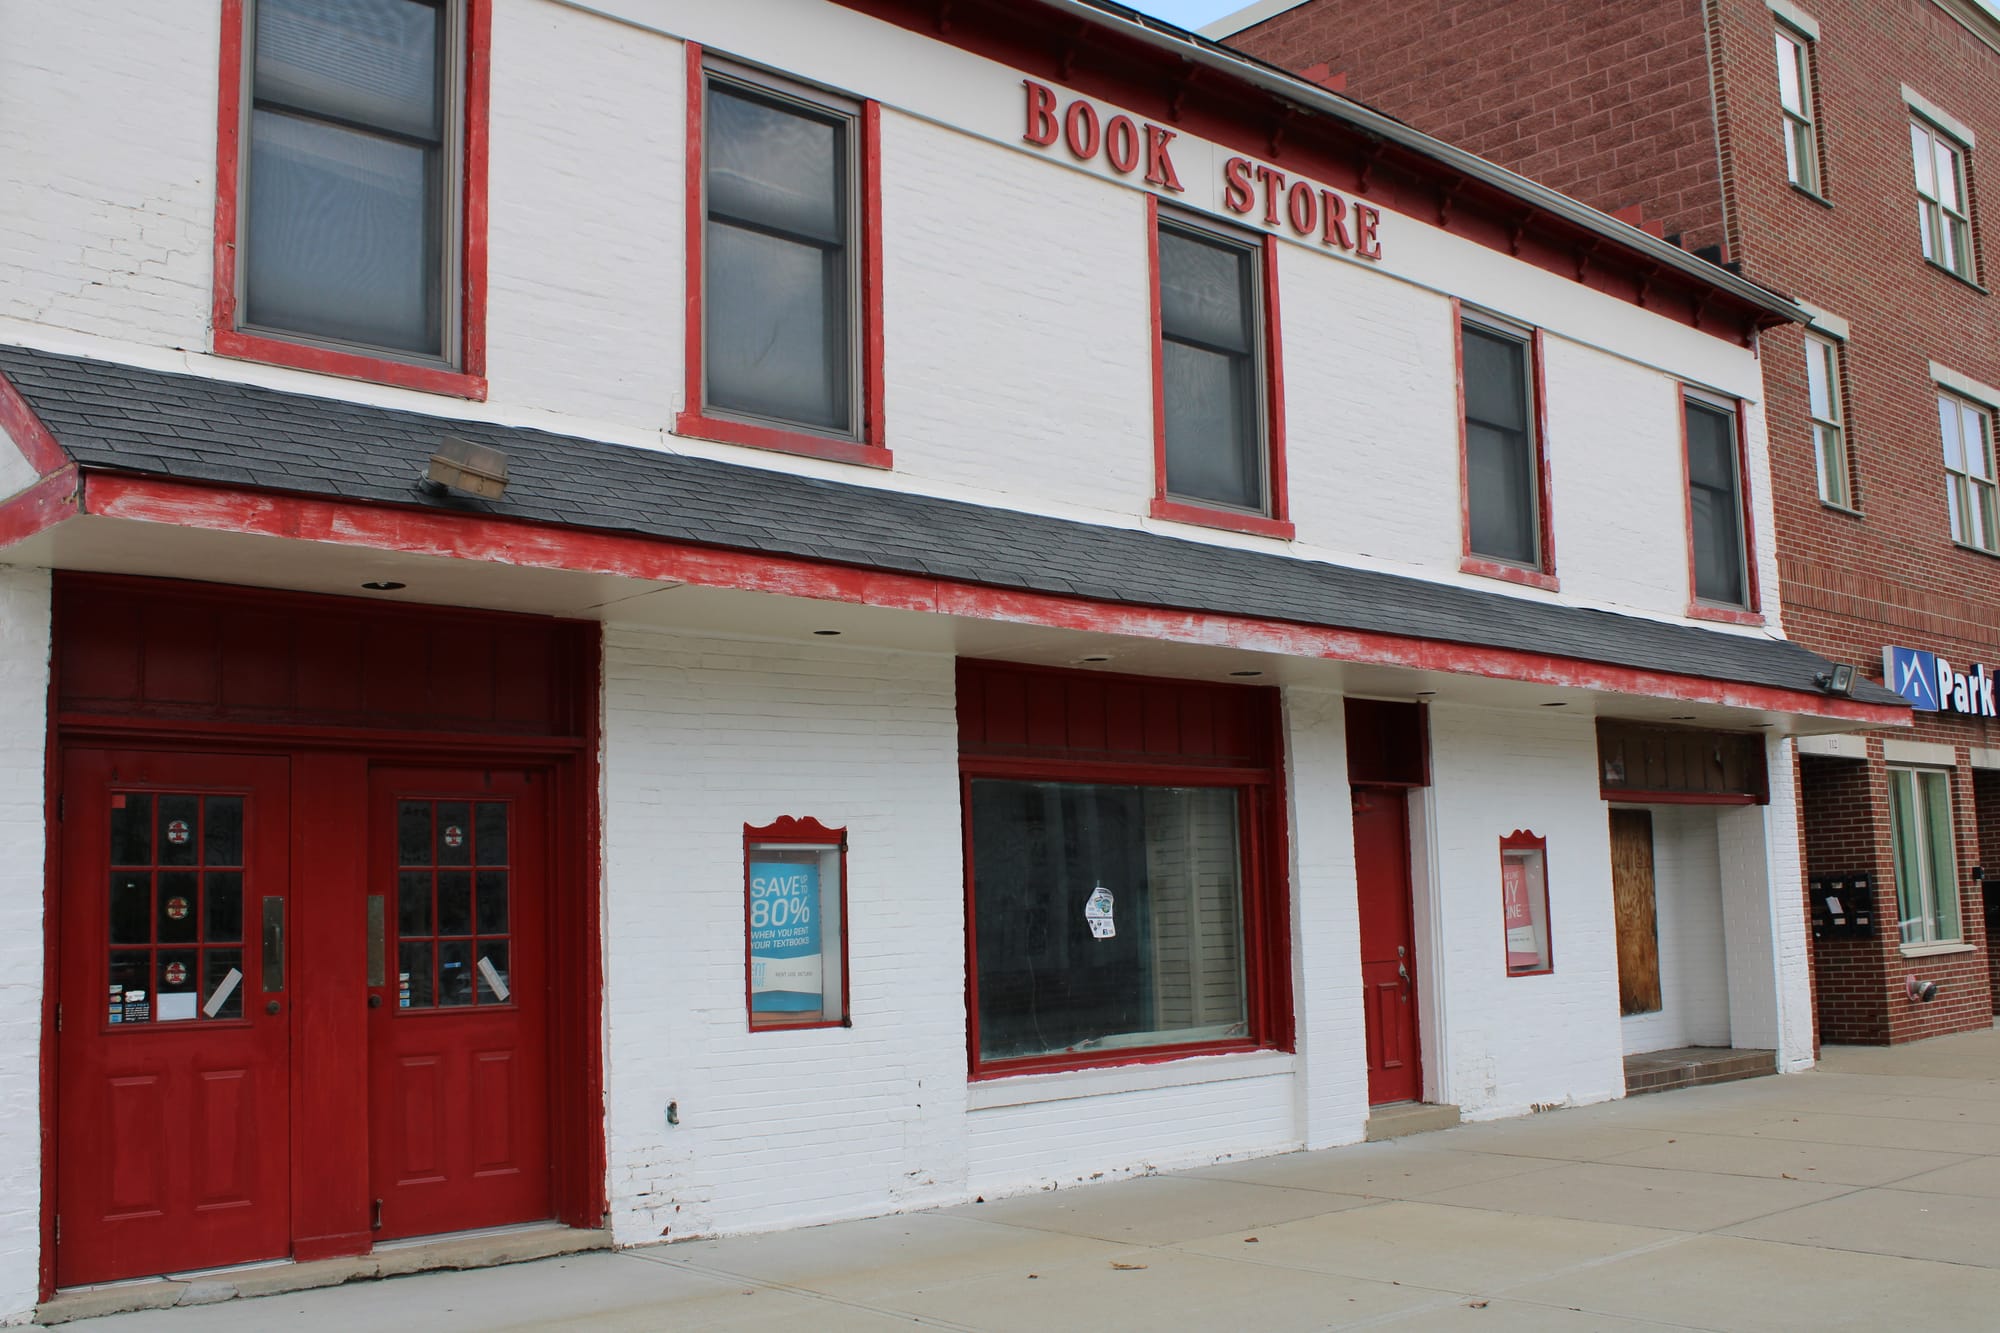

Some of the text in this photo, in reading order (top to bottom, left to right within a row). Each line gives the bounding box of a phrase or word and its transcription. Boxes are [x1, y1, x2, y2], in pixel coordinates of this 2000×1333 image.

[1022, 79, 1382, 260] BOOK STORE
[1936, 657, 1997, 718] Park
[751, 875, 800, 898] SAVE
[751, 896, 810, 928] 80%
[751, 927, 808, 938] WHEN YOU RENT
[774, 937, 809, 947] TEXTBOOKS
